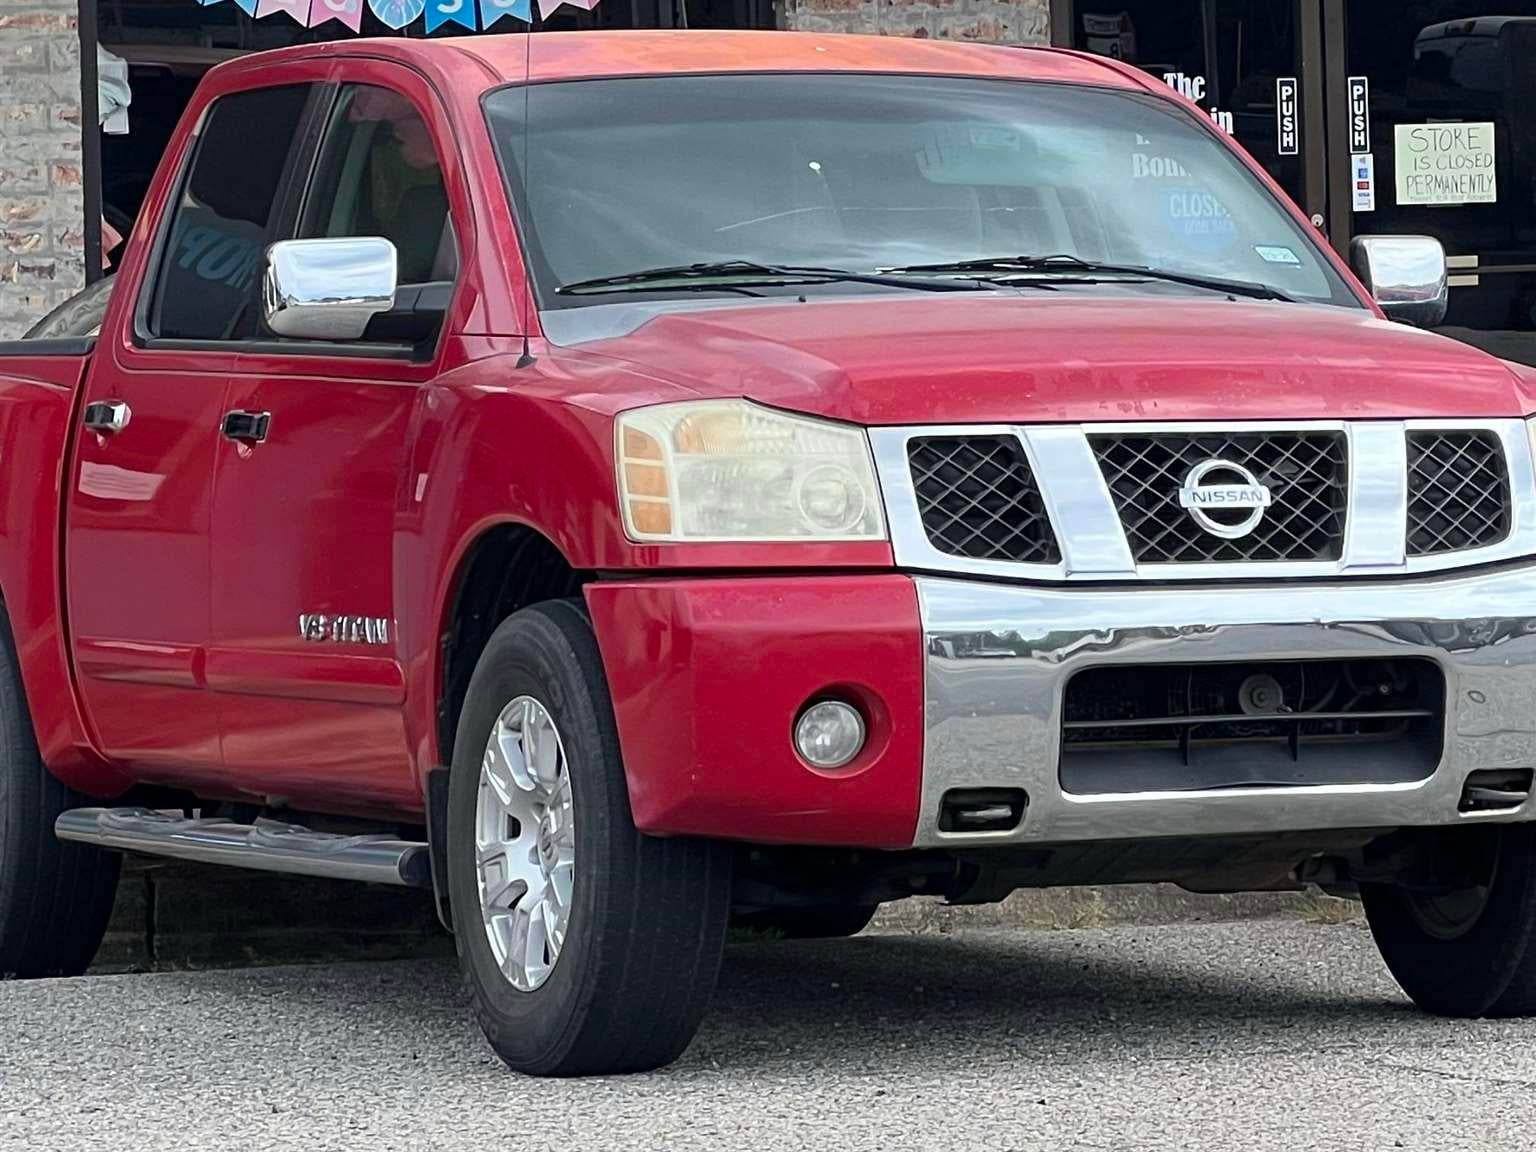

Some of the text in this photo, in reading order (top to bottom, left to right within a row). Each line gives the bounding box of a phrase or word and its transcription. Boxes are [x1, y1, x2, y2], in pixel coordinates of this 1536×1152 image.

[1163, 73, 1206, 103] The
[1281, 86, 1294, 148] PUSH
[1353, 85, 1366, 147] PUSH
[1408, 127, 1483, 152] STORE
[1414, 153, 1493, 171] IS CLOSED
[1170, 193, 1232, 219] CLOSE
[1191, 490, 1264, 503] NISSAN
